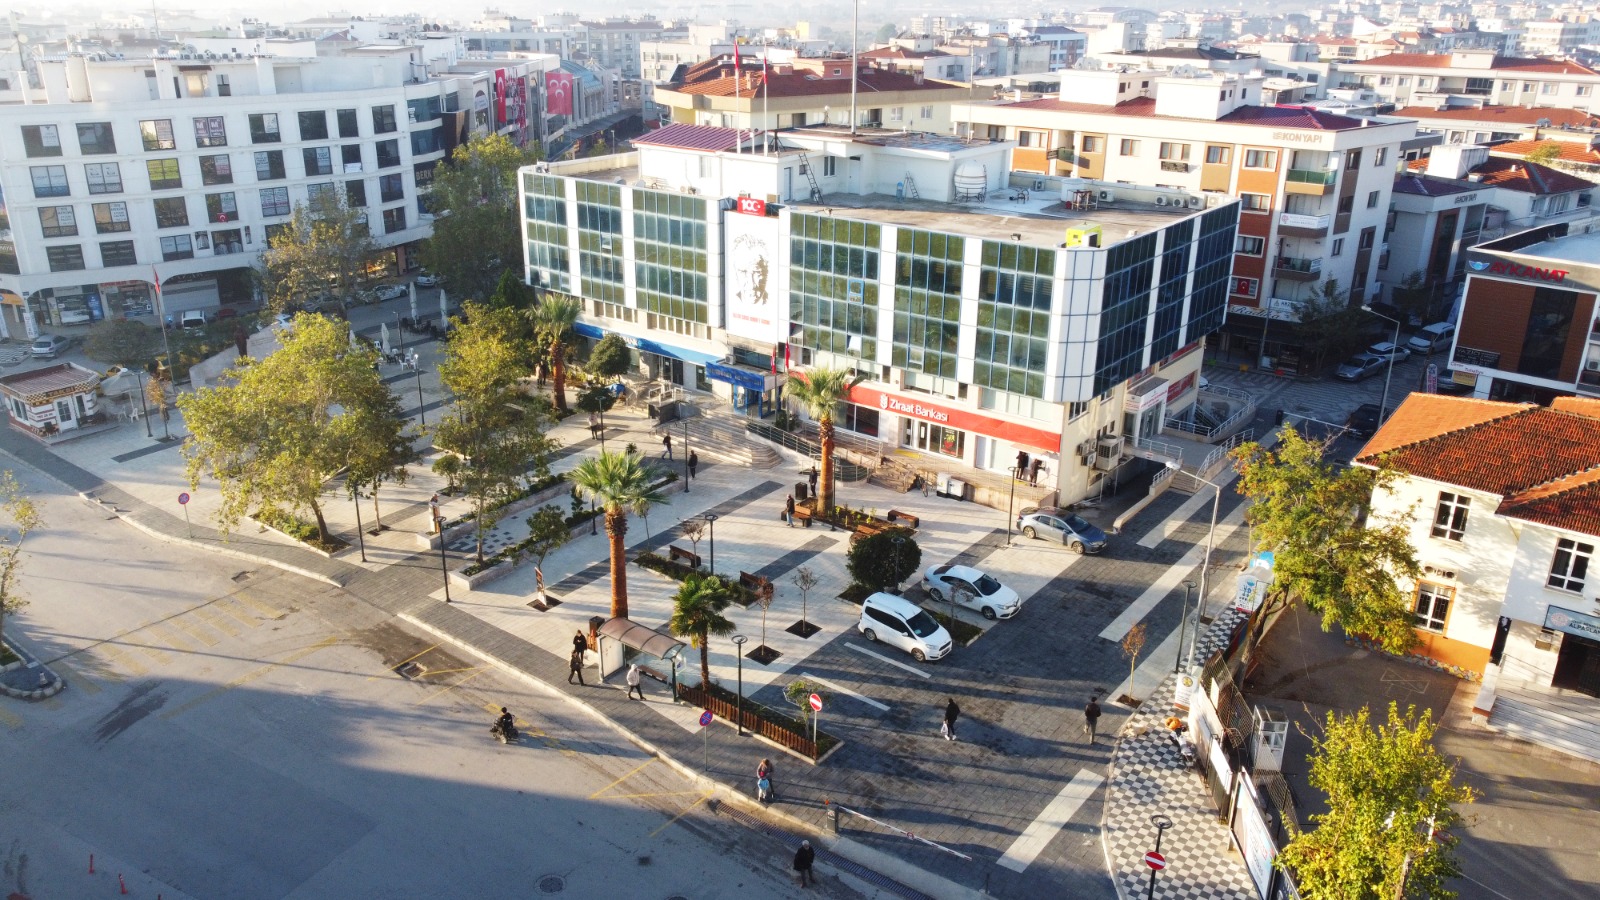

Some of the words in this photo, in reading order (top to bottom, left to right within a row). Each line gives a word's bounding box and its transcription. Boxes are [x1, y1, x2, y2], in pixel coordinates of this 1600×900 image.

[416, 169, 432, 181] BERK
[1489, 261, 1570, 282] AYKANAT
[889, 398, 915, 414] Ziraat
[915, 404, 949, 422] Bankası
